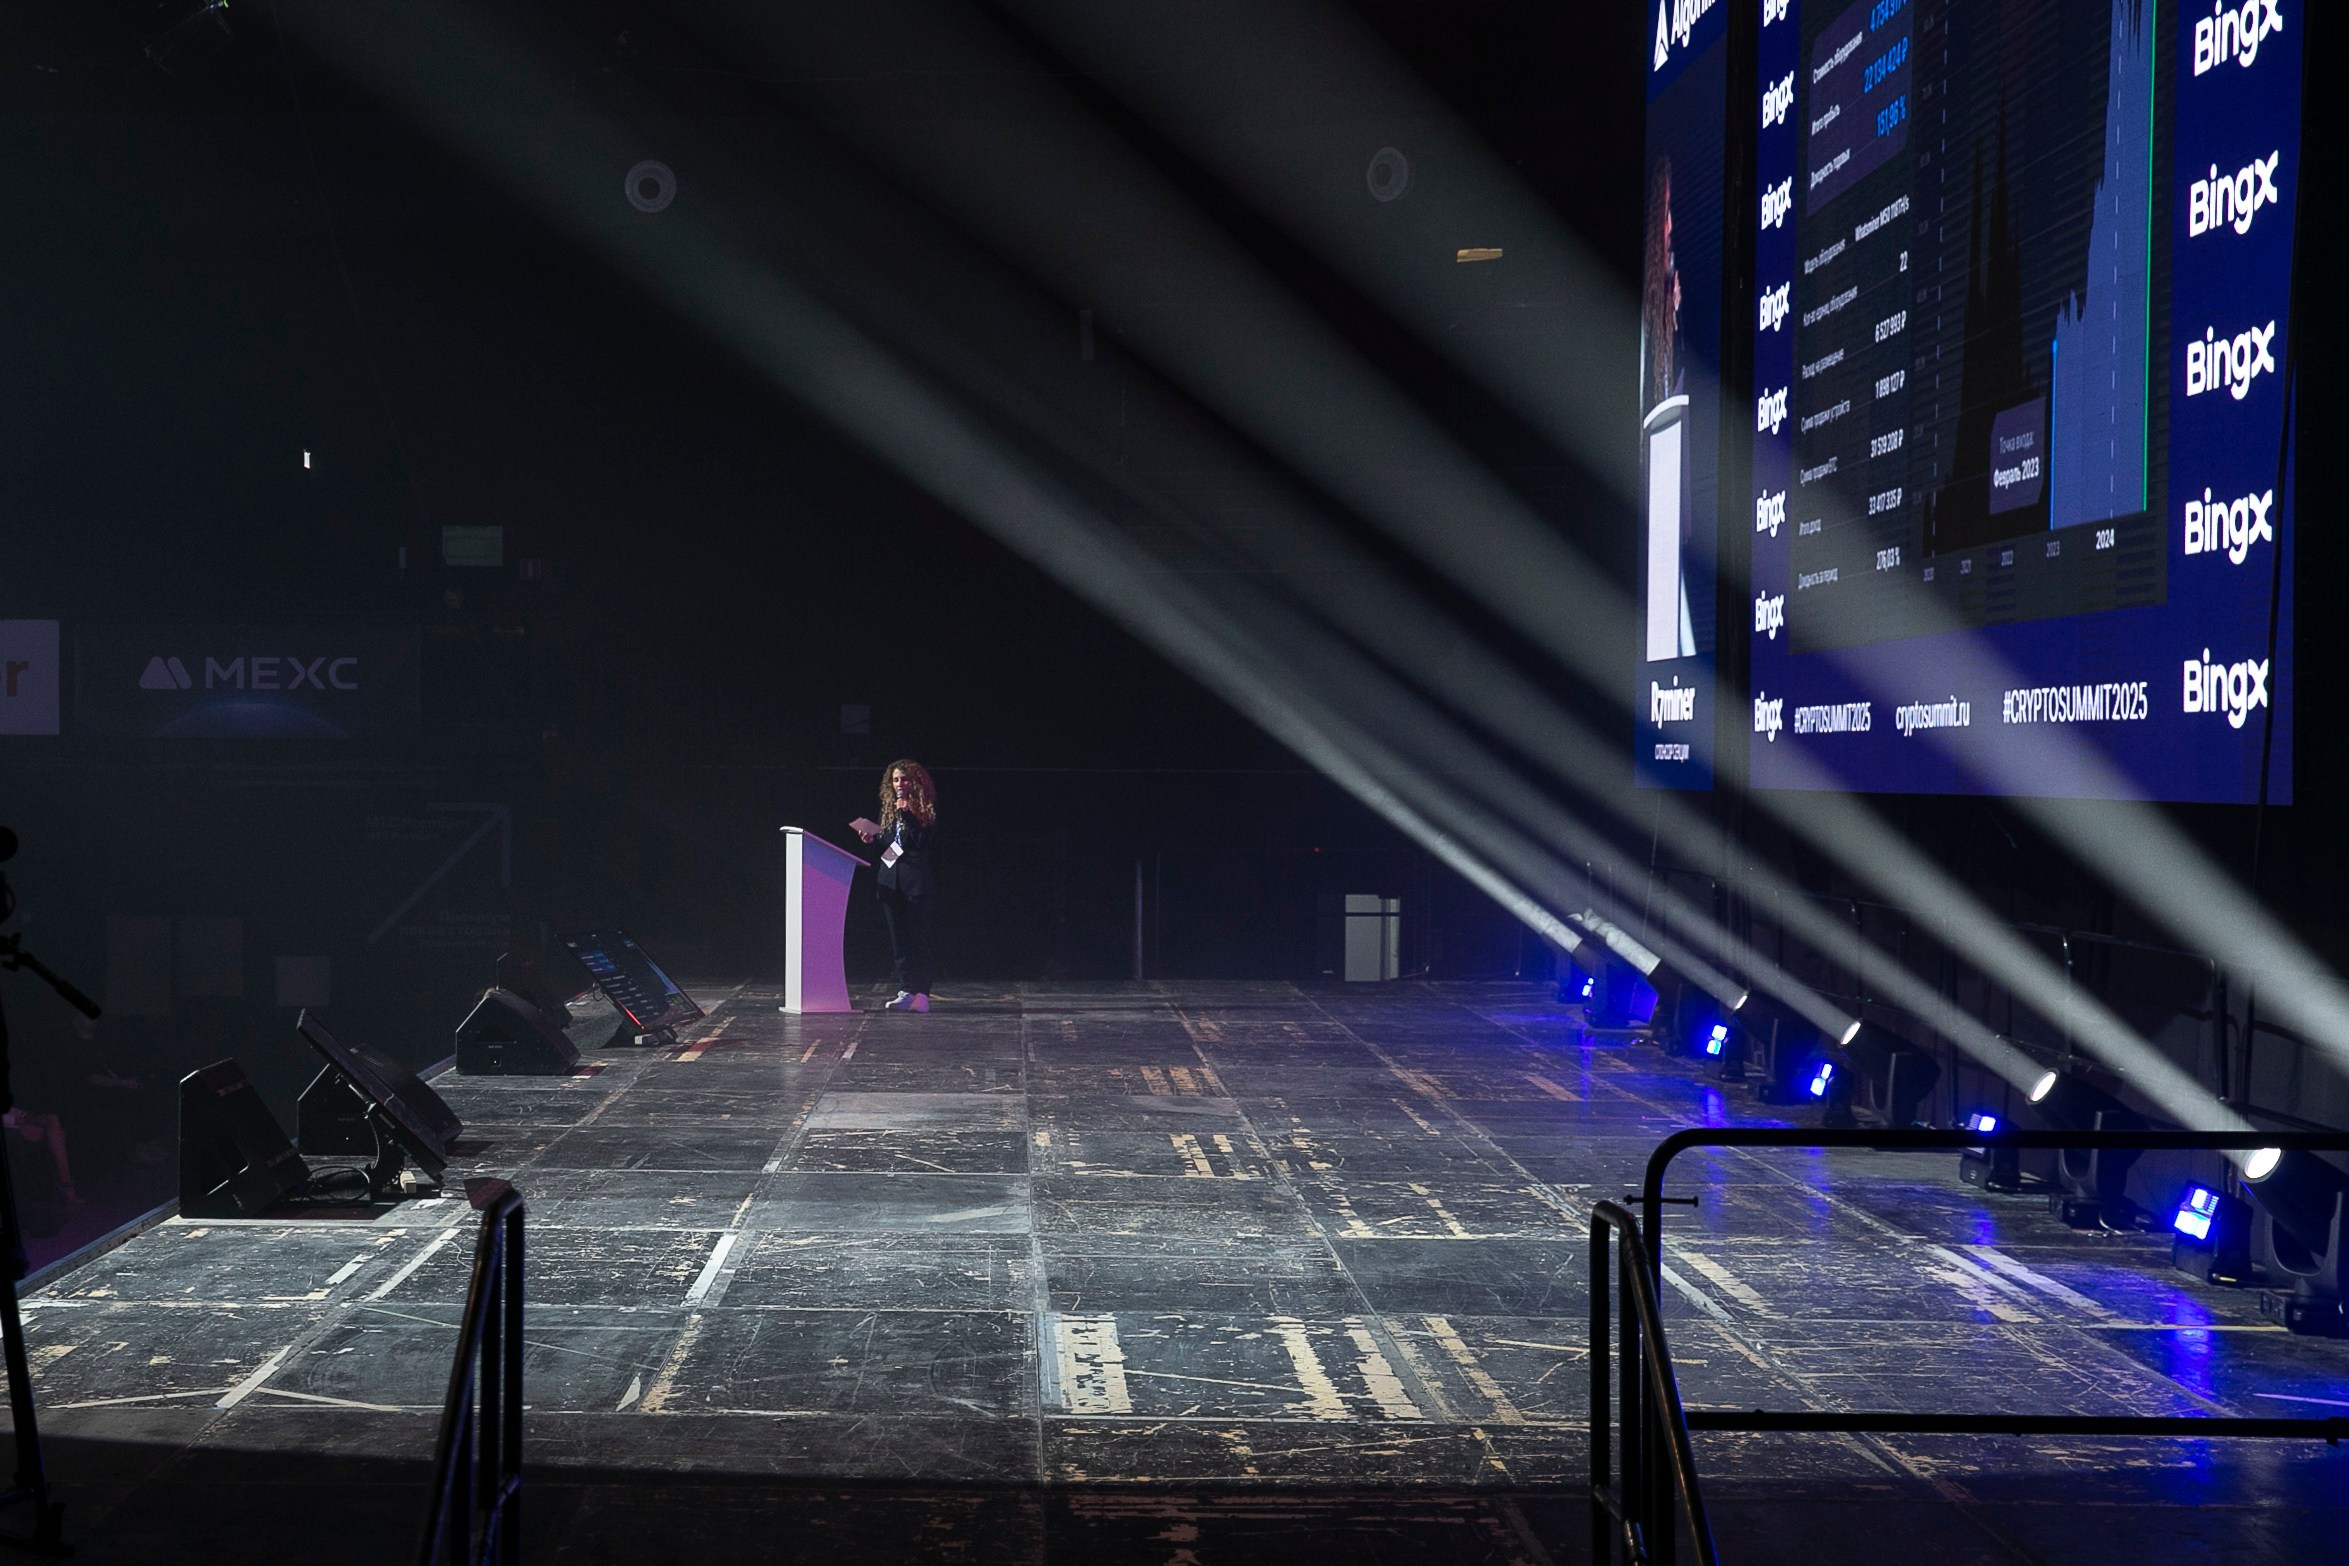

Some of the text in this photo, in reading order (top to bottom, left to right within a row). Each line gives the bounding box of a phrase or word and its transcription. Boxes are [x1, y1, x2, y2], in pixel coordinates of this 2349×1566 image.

[1900, 251, 1907, 272] 22
[1994, 457, 2039, 488] Февраль 2023
[2096, 529, 2114, 549] 2024
[205, 656, 358, 690] MEXC
[1794, 702, 1871, 734] #CRYPTOSUMMIT2025
[1896, 695, 1970, 736] cryptosummit.ru
[2003, 682, 2148, 724] #CRYPTOSUMMIT2025
